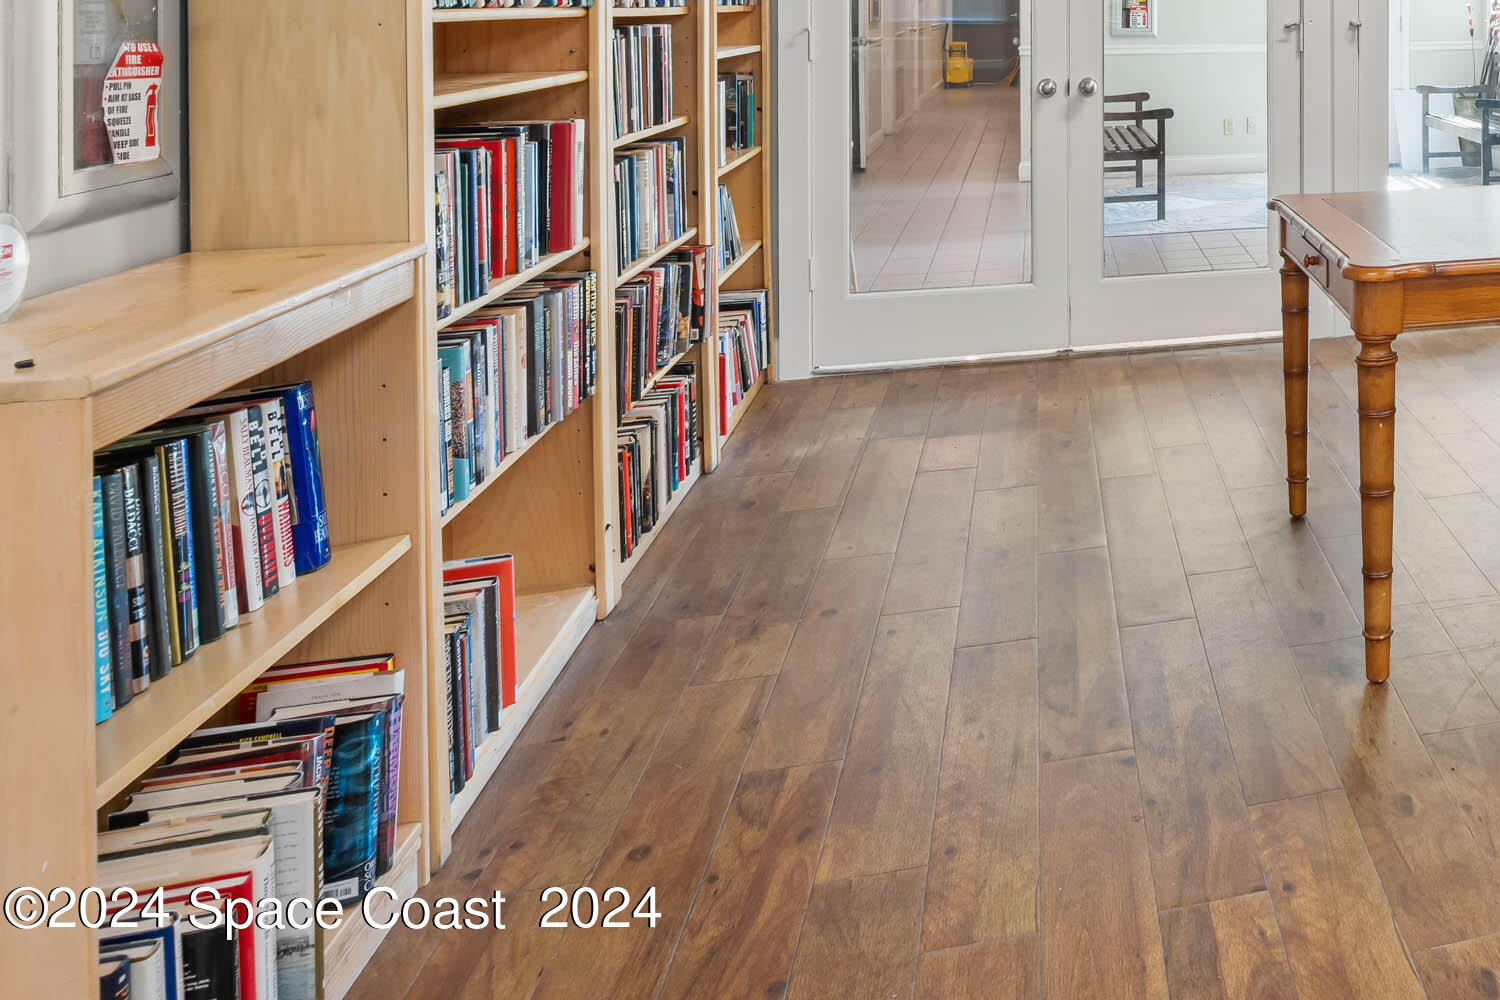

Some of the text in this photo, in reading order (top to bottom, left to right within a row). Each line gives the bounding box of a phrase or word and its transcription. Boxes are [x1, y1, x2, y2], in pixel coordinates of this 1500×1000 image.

[137, 42, 152, 53] USE
[125, 54, 142, 65] FIRE
[109, 65, 160, 78] XTINGUISHER
[108, 81, 132, 92] PULL PIN
[107, 94, 120, 103] AIM
[121, 93, 128, 102] AT
[107, 105, 129, 115] OF FIRE
[107, 116, 132, 127] SQUEEZE
[109, 128, 130, 138] ANDLE
[129, 138, 140, 148] SIDE
[240, 417, 250, 445] SALLY
[267, 411, 296, 568] BELL WARRIORS
[248, 419, 279, 588] BELL OVERKILL
[124, 487, 139, 552] BALDACCI
[93, 536, 109, 623] ATKINSON
[98, 664, 112, 695] SKY
[253, 732, 283, 743] CAMPBELL
[323, 727, 336, 769] DEEP
[315, 755, 323, 783] JACK
